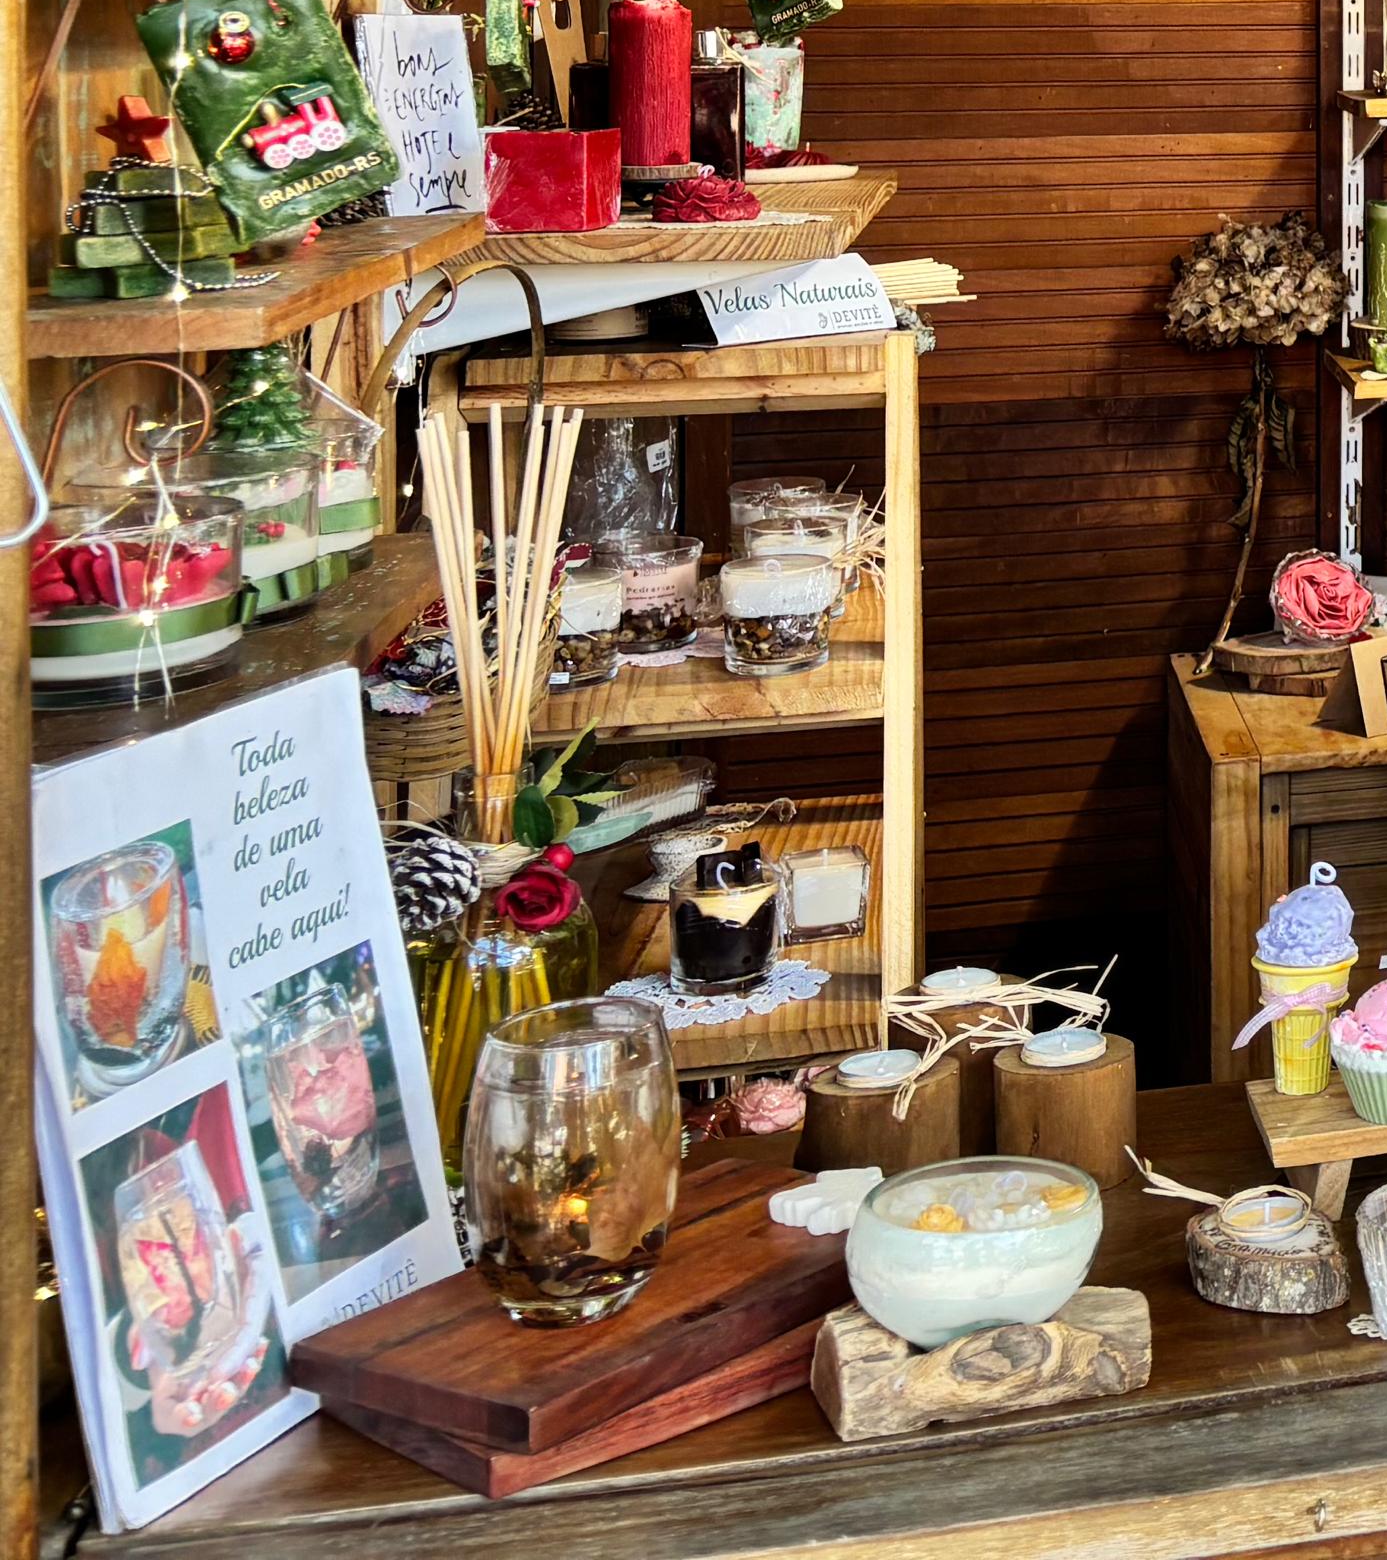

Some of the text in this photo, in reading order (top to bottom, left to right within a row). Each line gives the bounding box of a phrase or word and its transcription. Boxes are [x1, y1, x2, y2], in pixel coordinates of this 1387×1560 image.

[402, 129, 442, 174] HOJE
[258, 151, 383, 210] GRAMADO-RS
[704, 277, 879, 315] Velas Naturais
[231, 729, 296, 778] Toda
[234, 775, 309, 826] beleza
[233, 816, 323, 873] de uma
[260, 857, 310, 909] vela
[228, 883, 351, 970] cabe aqui!
